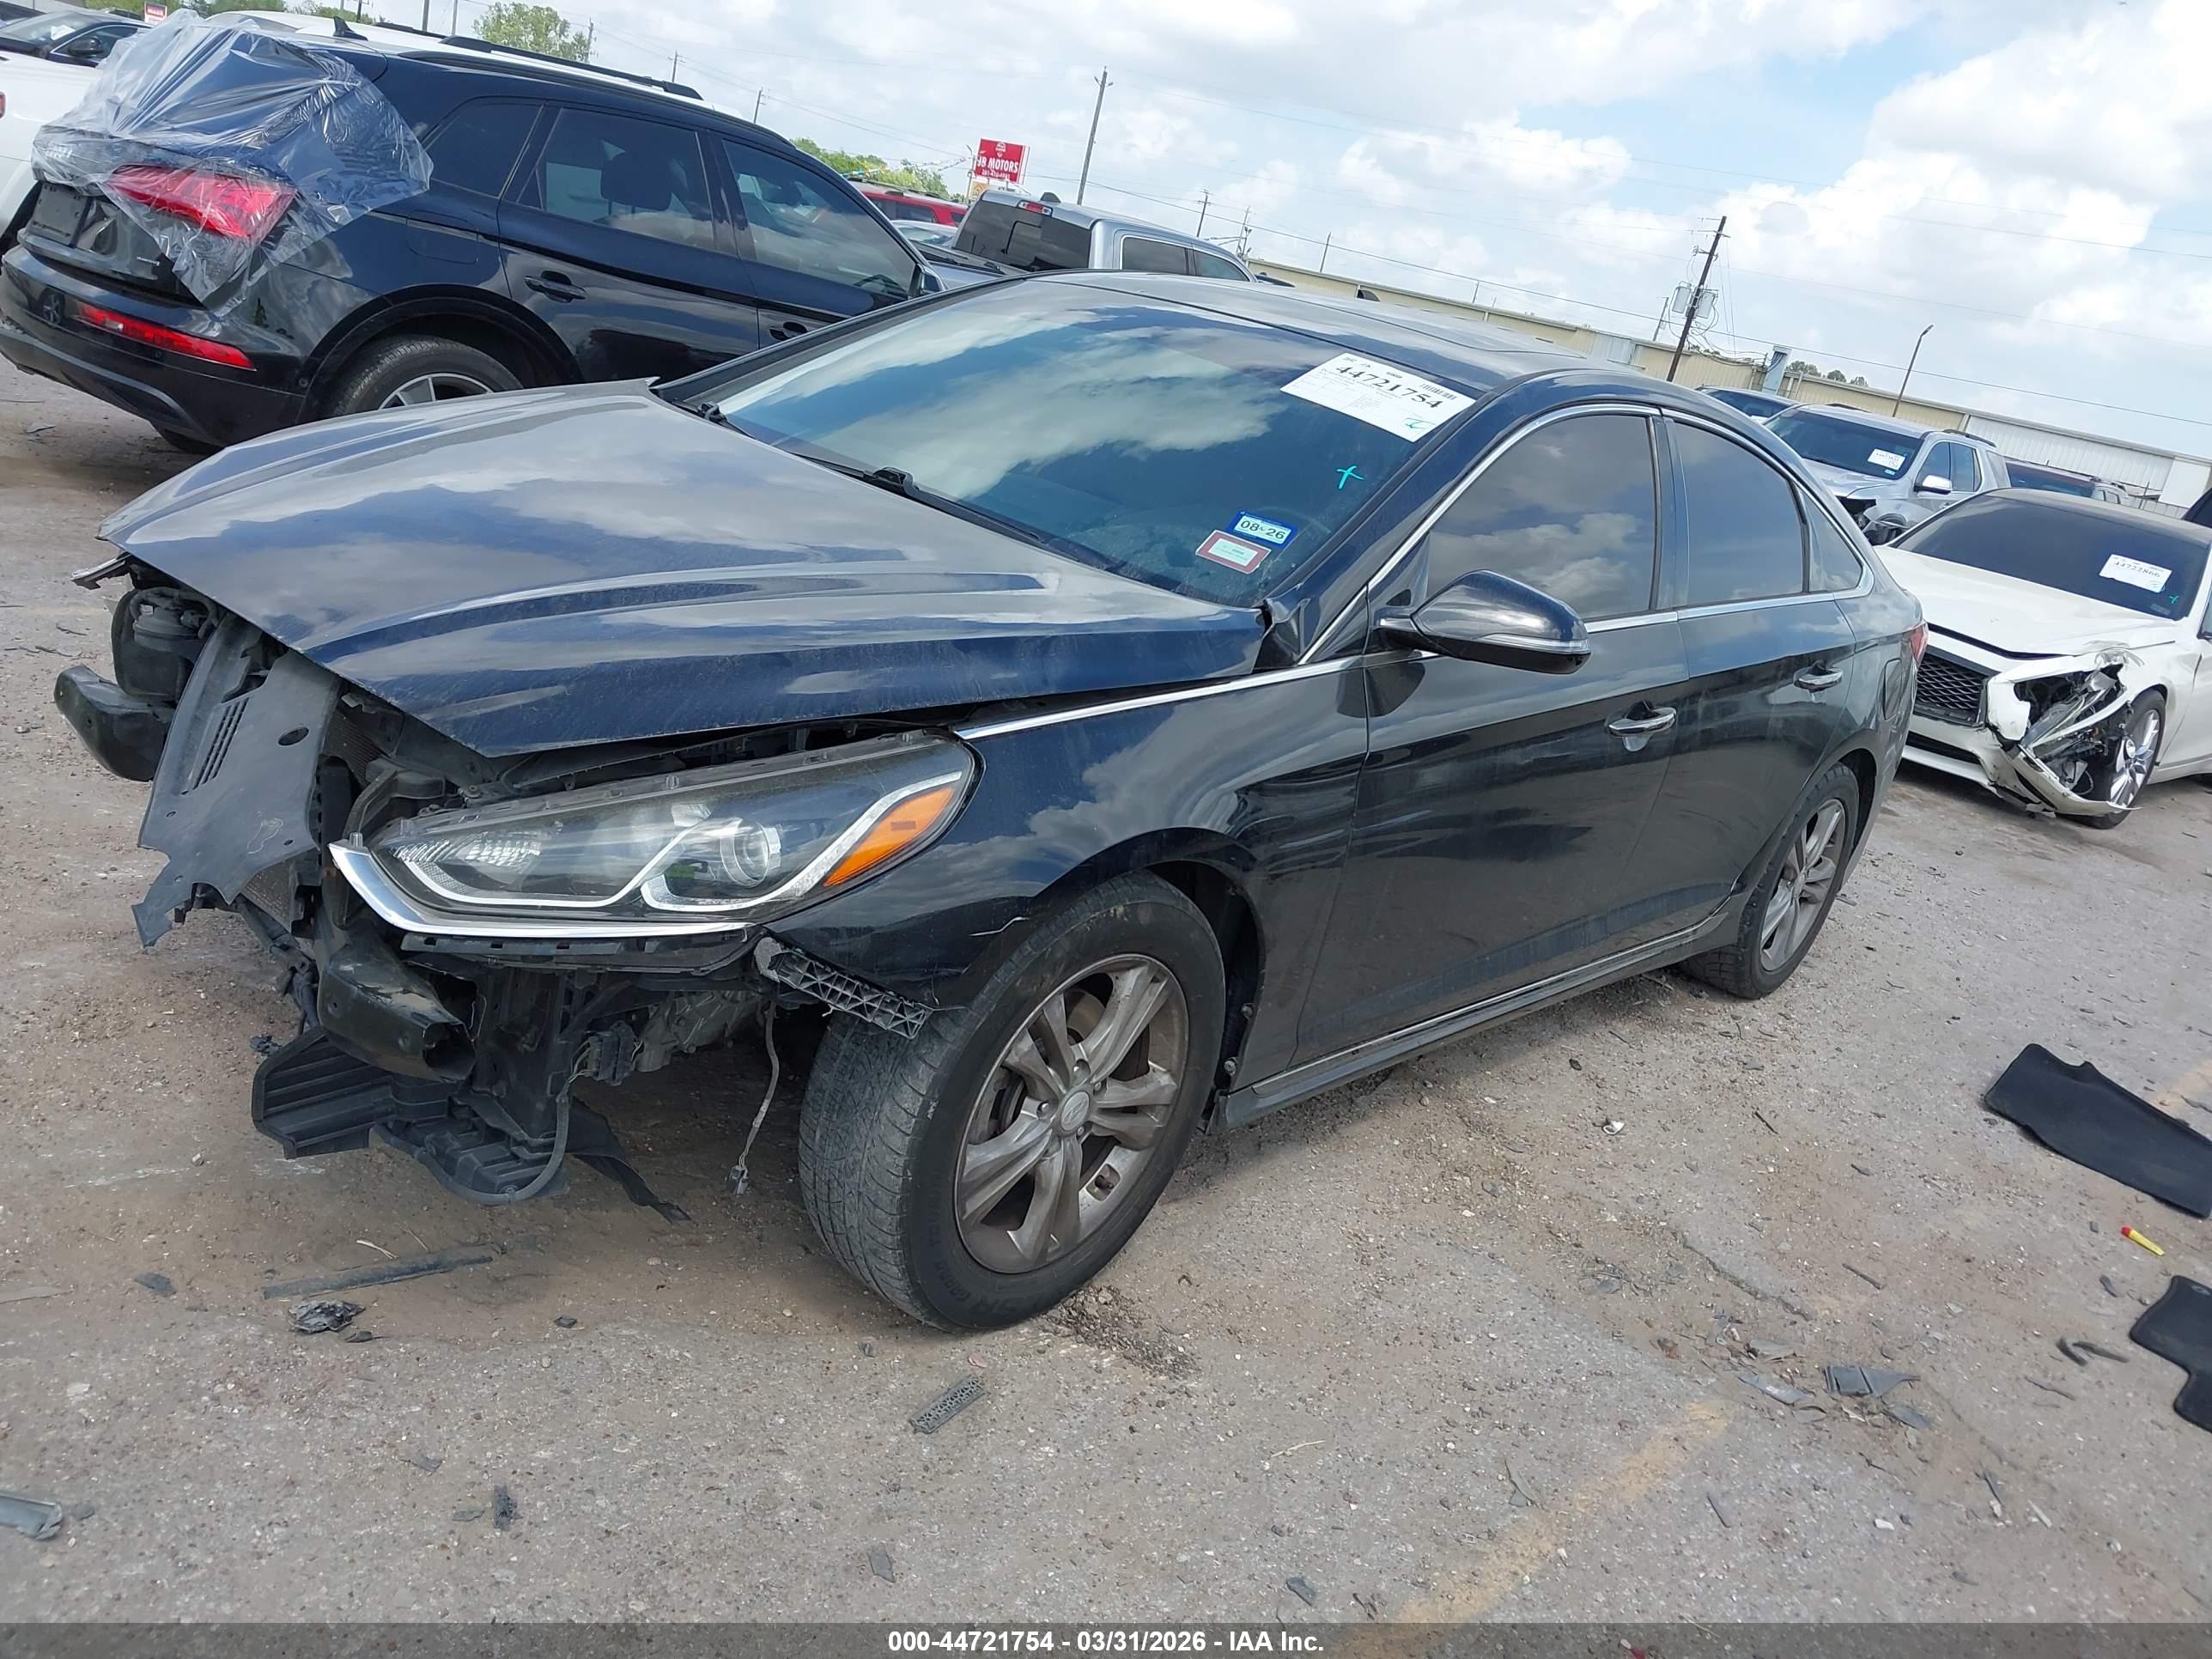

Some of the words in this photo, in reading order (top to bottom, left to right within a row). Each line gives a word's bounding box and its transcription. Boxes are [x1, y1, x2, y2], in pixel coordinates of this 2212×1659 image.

[988, 157, 1018, 173] MOTORS
[1335, 365, 1443, 408] 44721754
[1241, 520, 1260, 532] 08
[1266, 528, 1286, 539] 26
